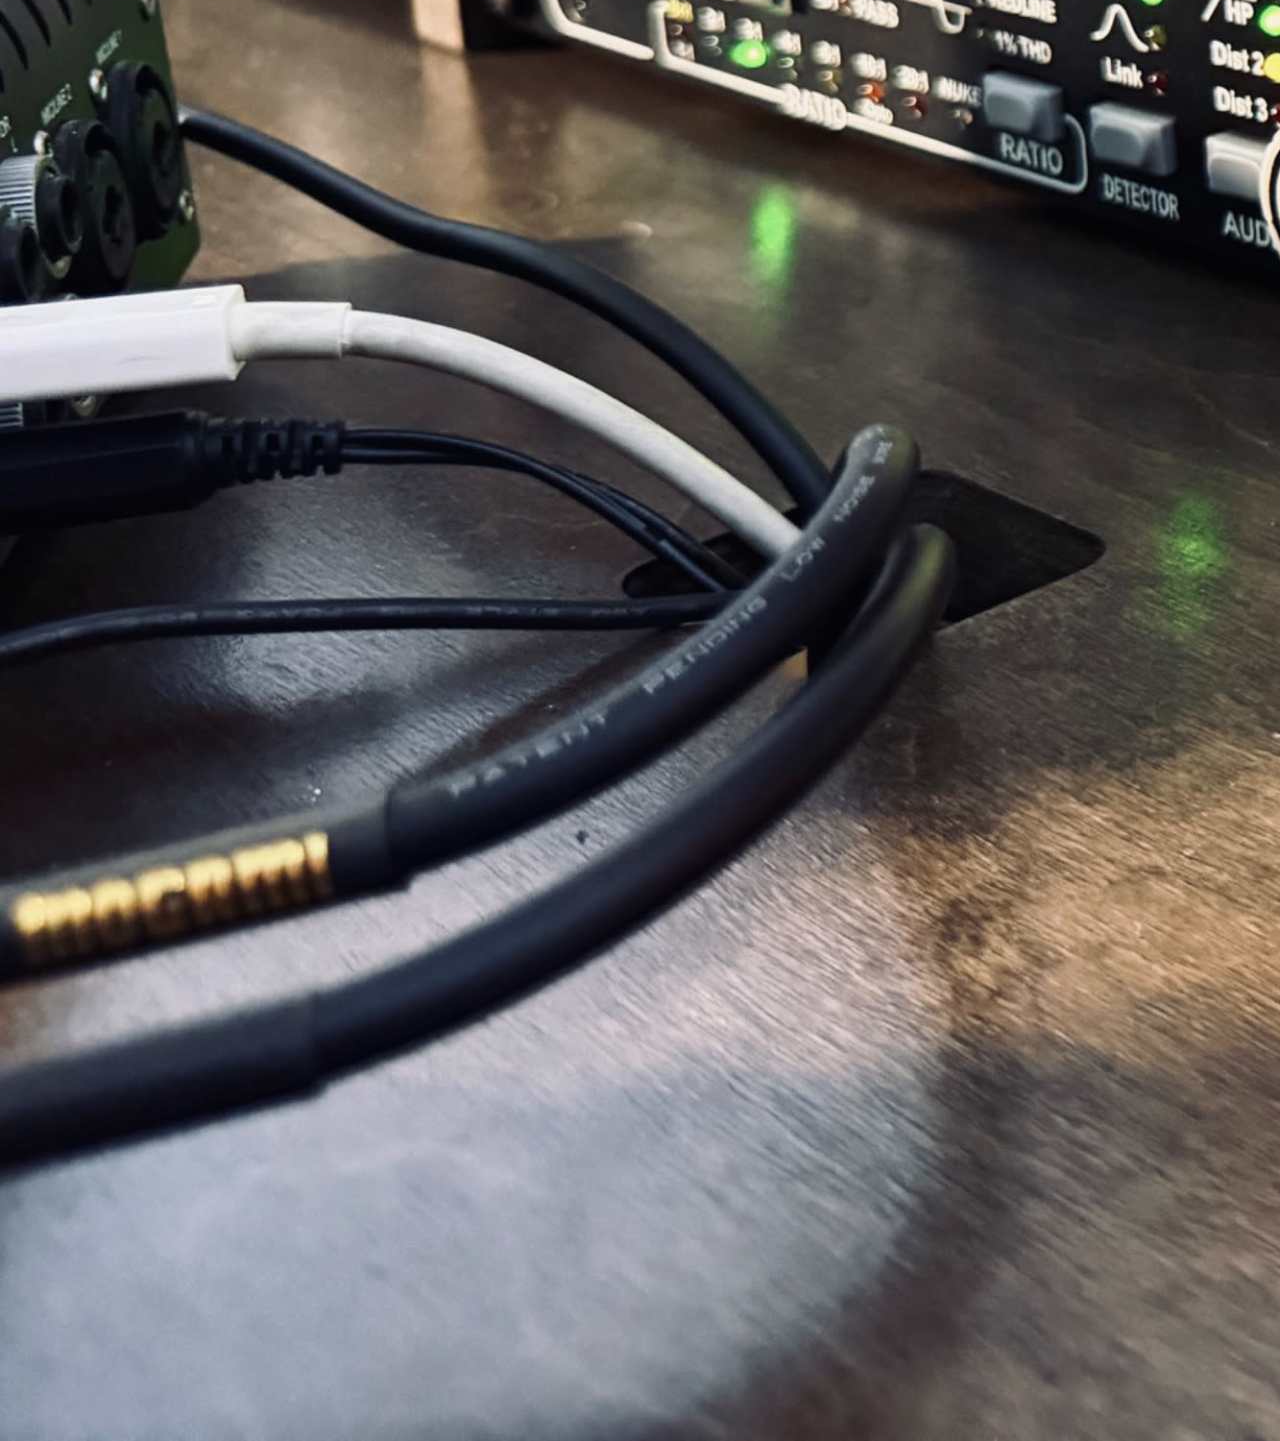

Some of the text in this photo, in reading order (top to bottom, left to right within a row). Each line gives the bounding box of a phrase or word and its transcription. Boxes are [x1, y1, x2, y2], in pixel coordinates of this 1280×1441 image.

[1102, 57, 1144, 89] Link
[1209, 40, 1252, 73] Dist
[1213, 85, 1253, 120] Dist
[999, 131, 1064, 176] RATIO
[1102, 172, 1181, 221] DETECTOR
[1221, 211, 1276, 250] AUD
